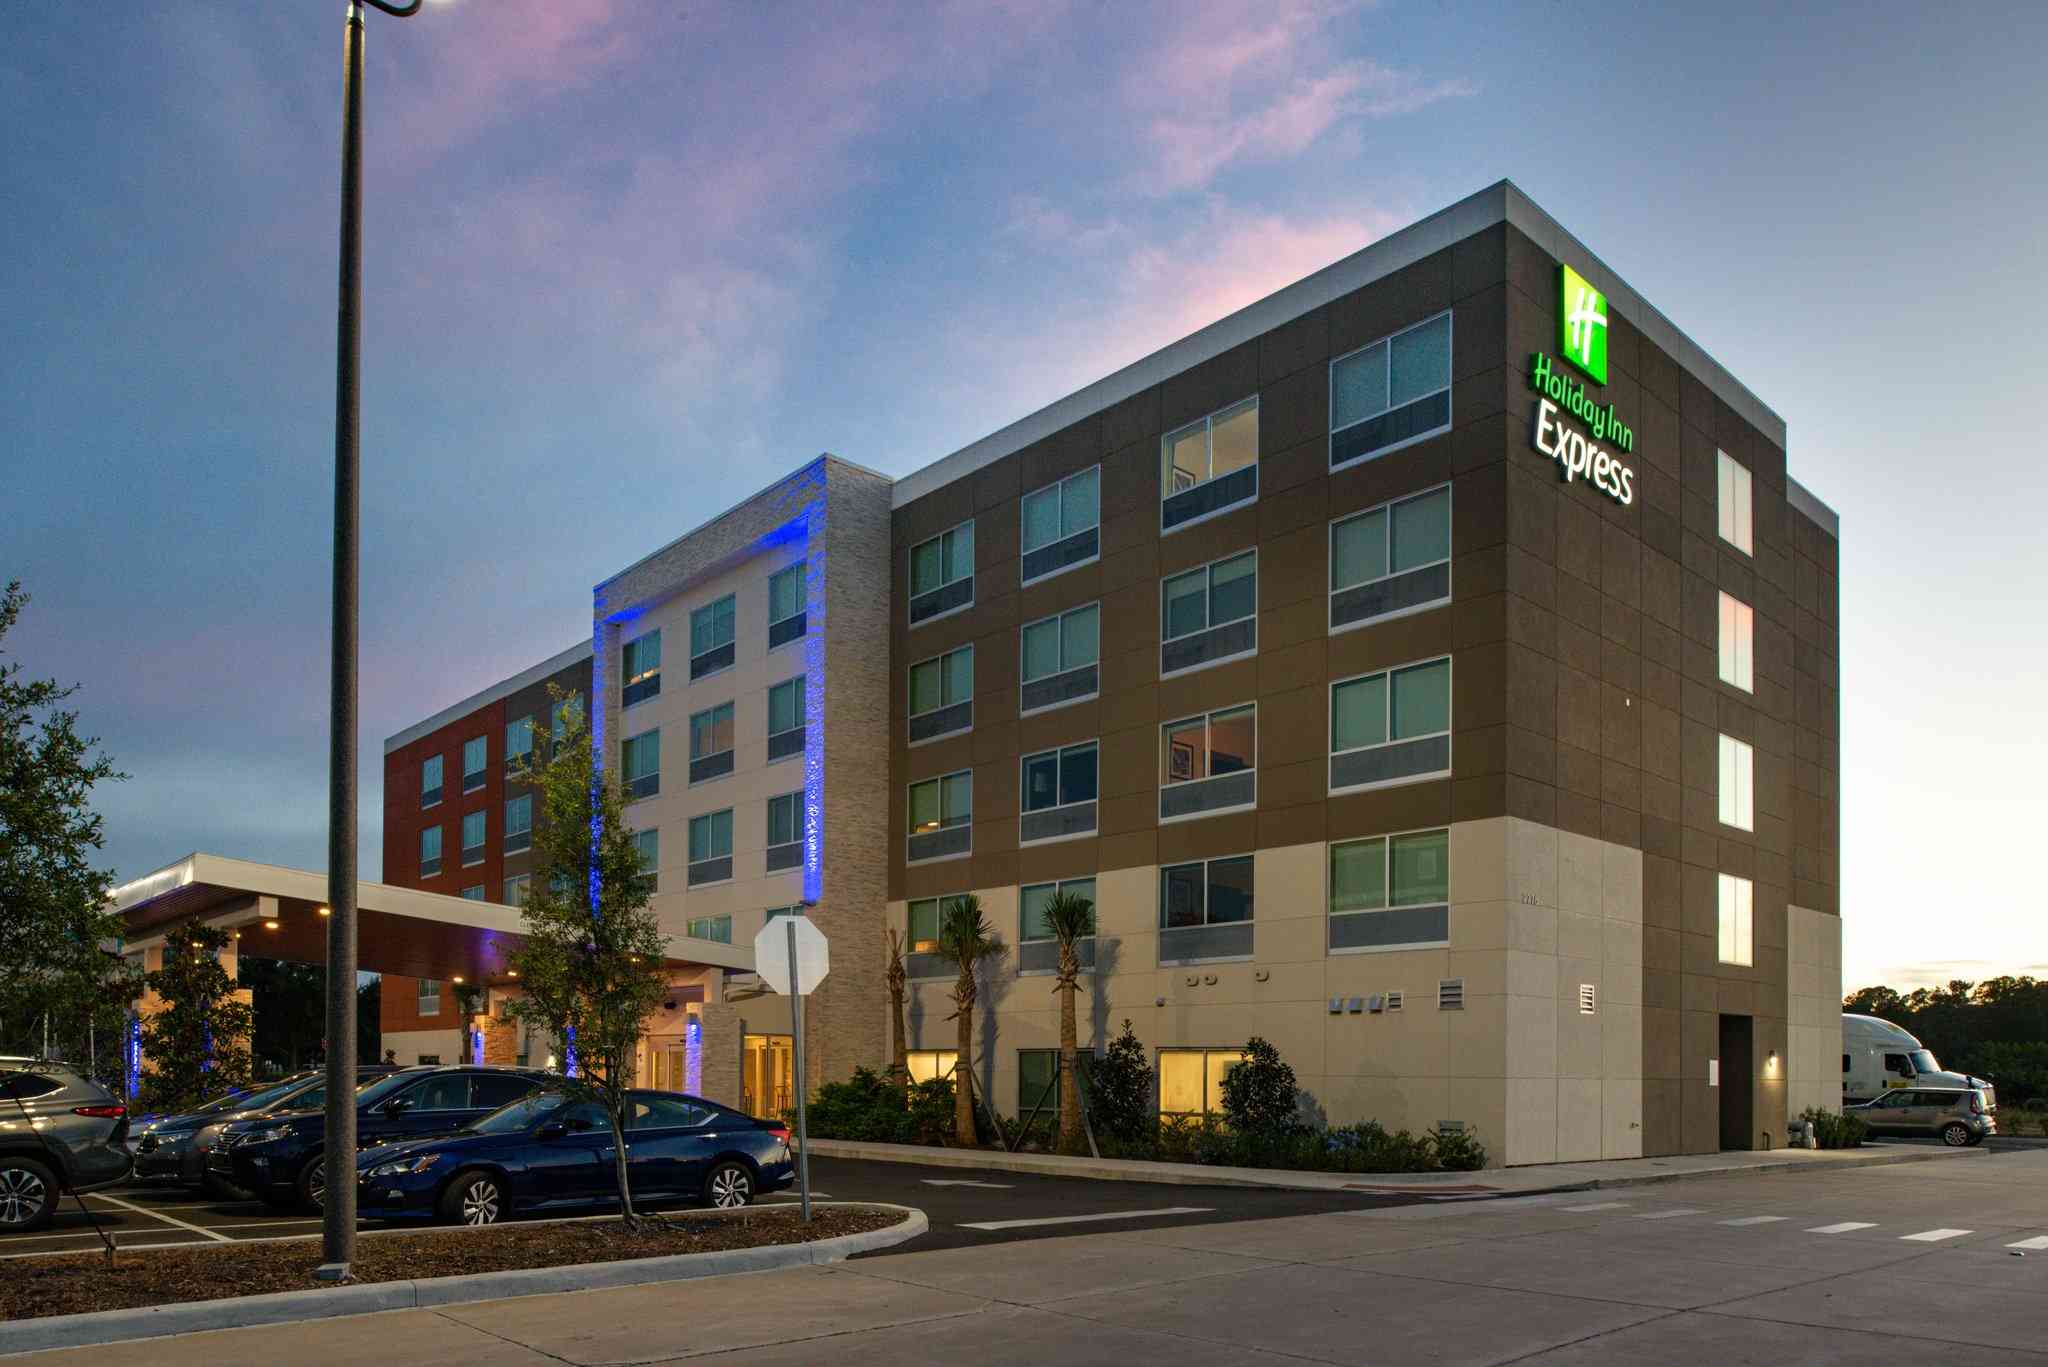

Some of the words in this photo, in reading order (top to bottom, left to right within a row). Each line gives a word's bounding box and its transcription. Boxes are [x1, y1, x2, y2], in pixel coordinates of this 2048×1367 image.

[1533, 351, 1606, 437] Holiday
[1607, 403, 1633, 452] Inn
[1536, 398, 1634, 505] Express
